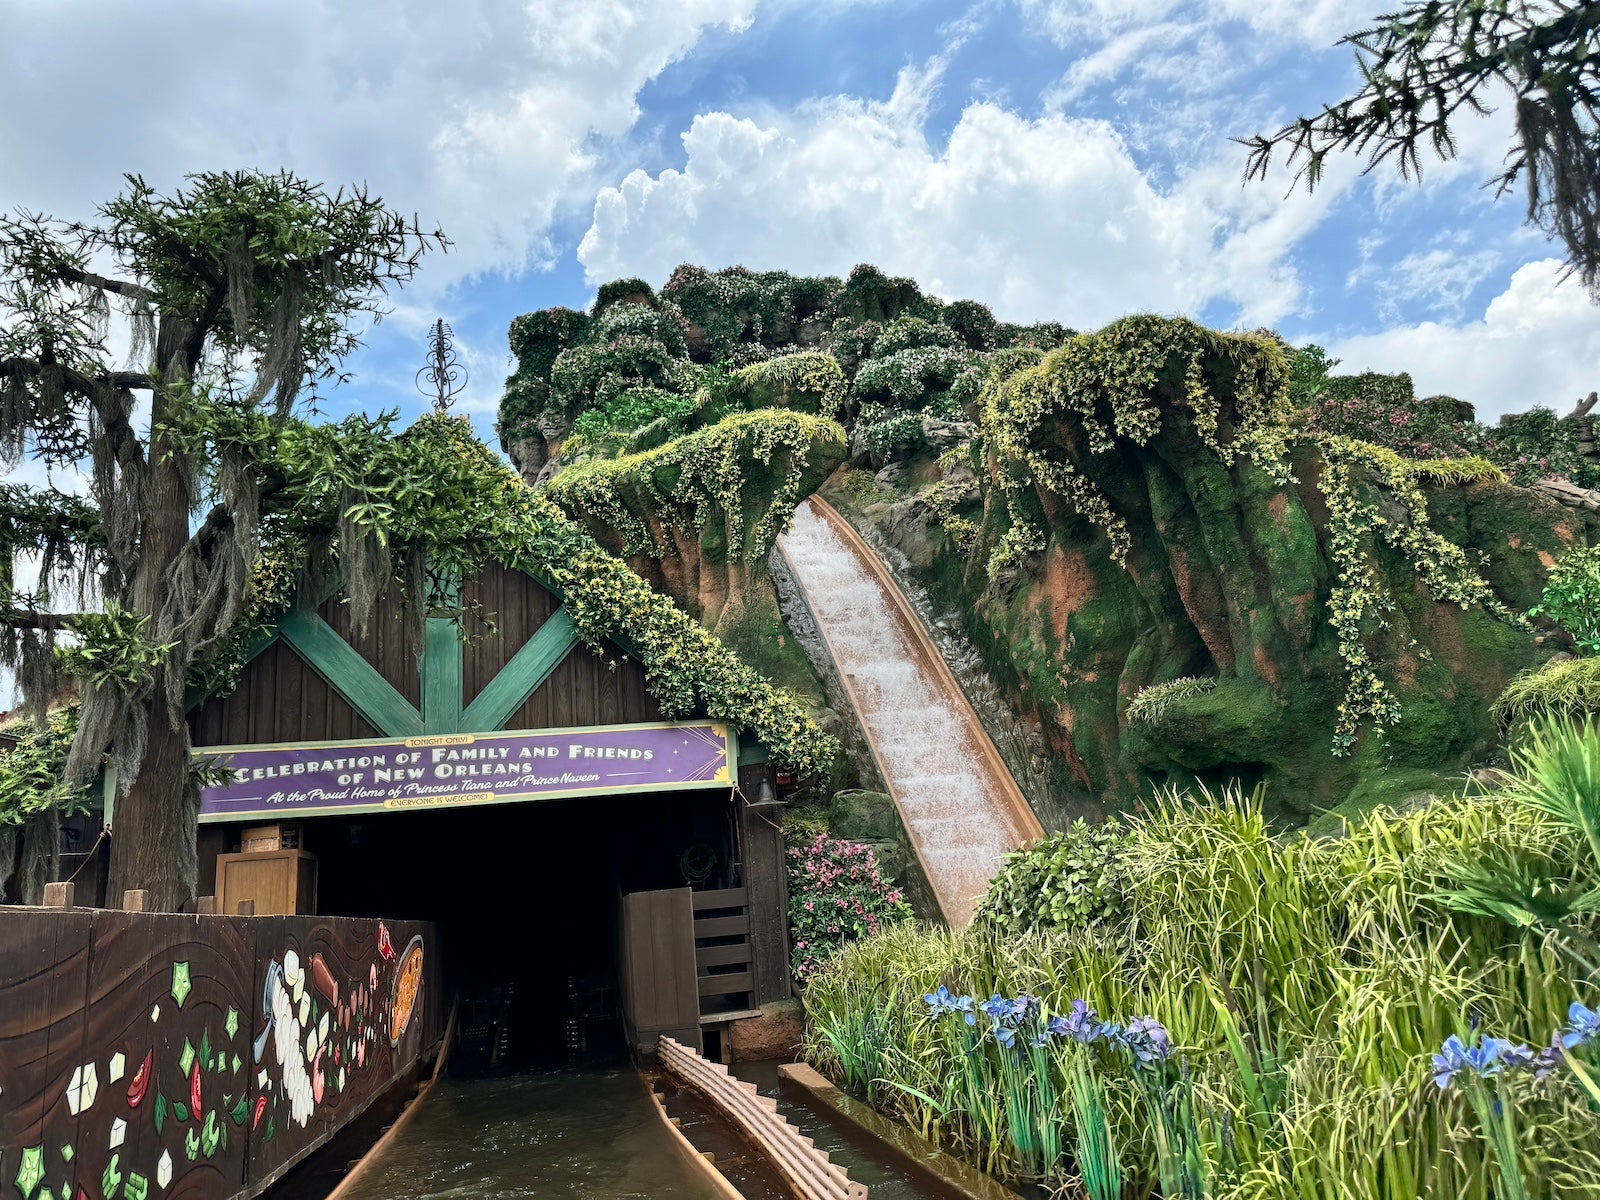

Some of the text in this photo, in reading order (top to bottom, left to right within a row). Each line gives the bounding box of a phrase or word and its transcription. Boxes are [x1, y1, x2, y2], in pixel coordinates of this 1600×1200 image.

[410, 736, 468, 746] TONIGHT ONLY!
[395, 752, 421, 764] OF
[431, 746, 511, 764] FAMILY
[519, 746, 560, 758] AND
[568, 744, 654, 760] FRIENDS
[338, 761, 533, 785] OF NEW ORLEANS
[266, 772, 600, 804] At the Proud Home of Princess Tiana and Prince Naveen
[390, 793, 489, 806] EVERYONE IS WELCOME!
